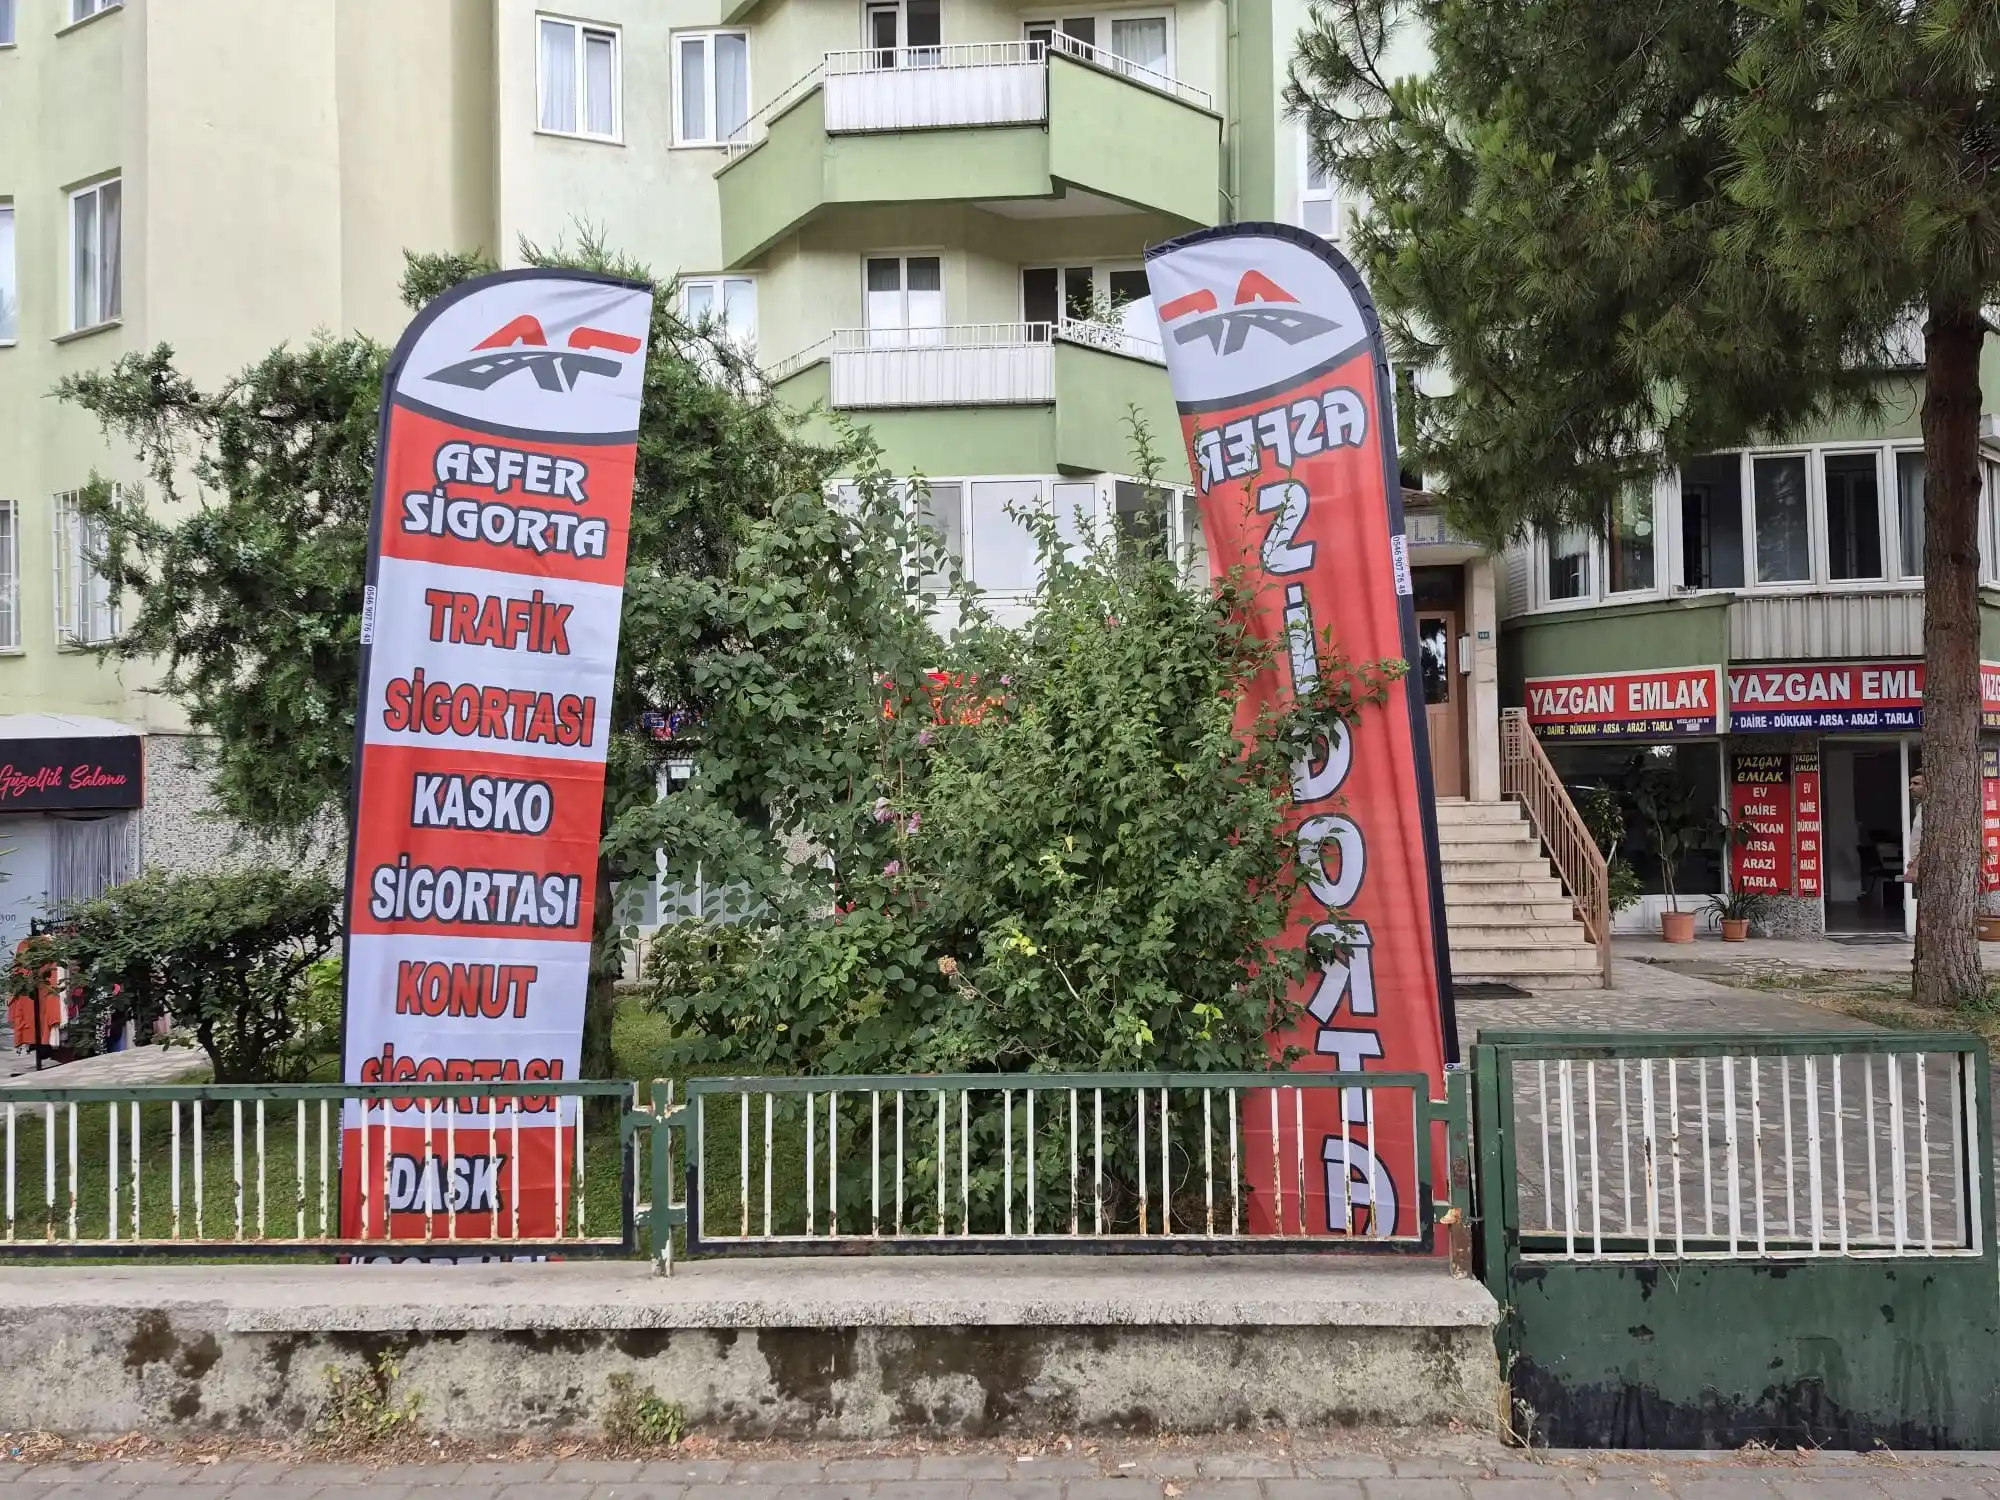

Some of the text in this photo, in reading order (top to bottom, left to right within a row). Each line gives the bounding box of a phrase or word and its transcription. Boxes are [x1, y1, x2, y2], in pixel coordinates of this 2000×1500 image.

[435, 442, 588, 502] ASFER
[402, 488, 608, 558] SİGORTA
[1395, 557, 1404, 570] 907
[425, 589, 573, 655] TRAFİK
[1530, 679, 1709, 716] YAZGAN EMLAK
[1728, 672, 1850, 703] YAZGAN
[383, 668, 596, 747] SİGORTASI
[1741, 716, 1767, 729] DAİRE
[1819, 714, 1844, 727] ARSA
[1851, 711, 1878, 726] ARAZİ
[1885, 712, 1914, 725] TARLA
[1602, 724, 1620, 734] ARSA
[1627, 721, 1647, 733] ARAZİ
[1652, 721, 1674, 732] TARLA
[1737, 756, 1782, 770] YAZGAN
[69, 765, 128, 790] Salonu
[411, 773, 552, 835] KASKO
[1753, 787, 1767, 798] EV
[1744, 803, 1776, 816] DAİRE
[1746, 841, 1776, 852] ARSA
[1743, 858, 1776, 870] ARAZİ
[369, 854, 579, 929] SİGORTASI
[1742, 875, 1777, 888] TARLA
[396, 960, 537, 1018] KONUT
[388, 1154, 506, 1213] DASK
